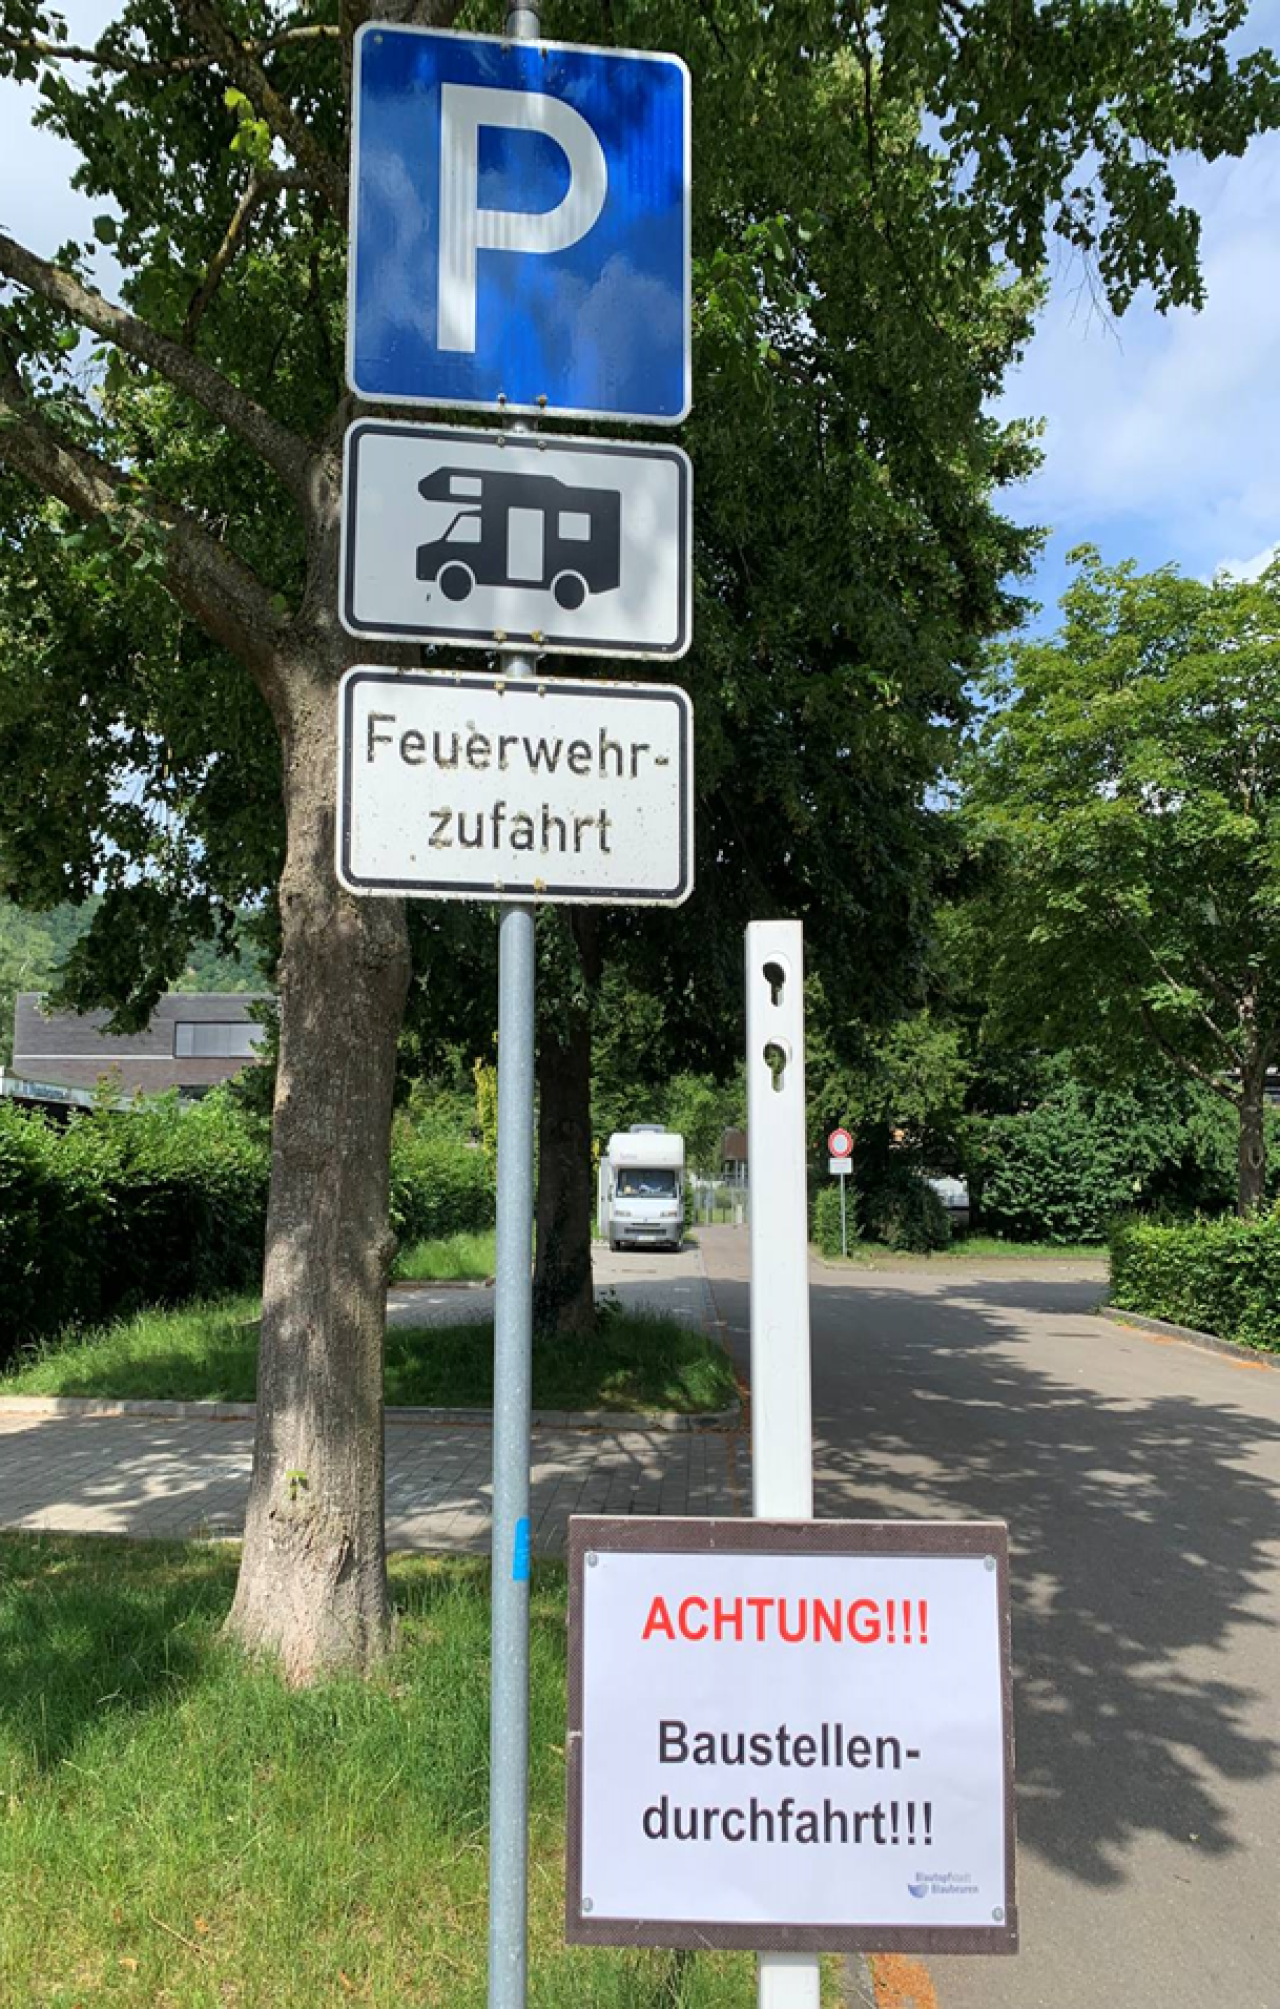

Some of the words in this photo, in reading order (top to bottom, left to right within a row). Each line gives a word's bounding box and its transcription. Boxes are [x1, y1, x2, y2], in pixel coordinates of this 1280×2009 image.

[437, 83, 608, 353] P
[367, 712, 669, 779] Feuerwehr-
[428, 800, 612, 853] zufahrt
[642, 1596, 929, 1644] ACHTUNG!!!
[658, 1720, 921, 1769] Baustellen-
[642, 1795, 933, 1845] durchfahrt!!!
